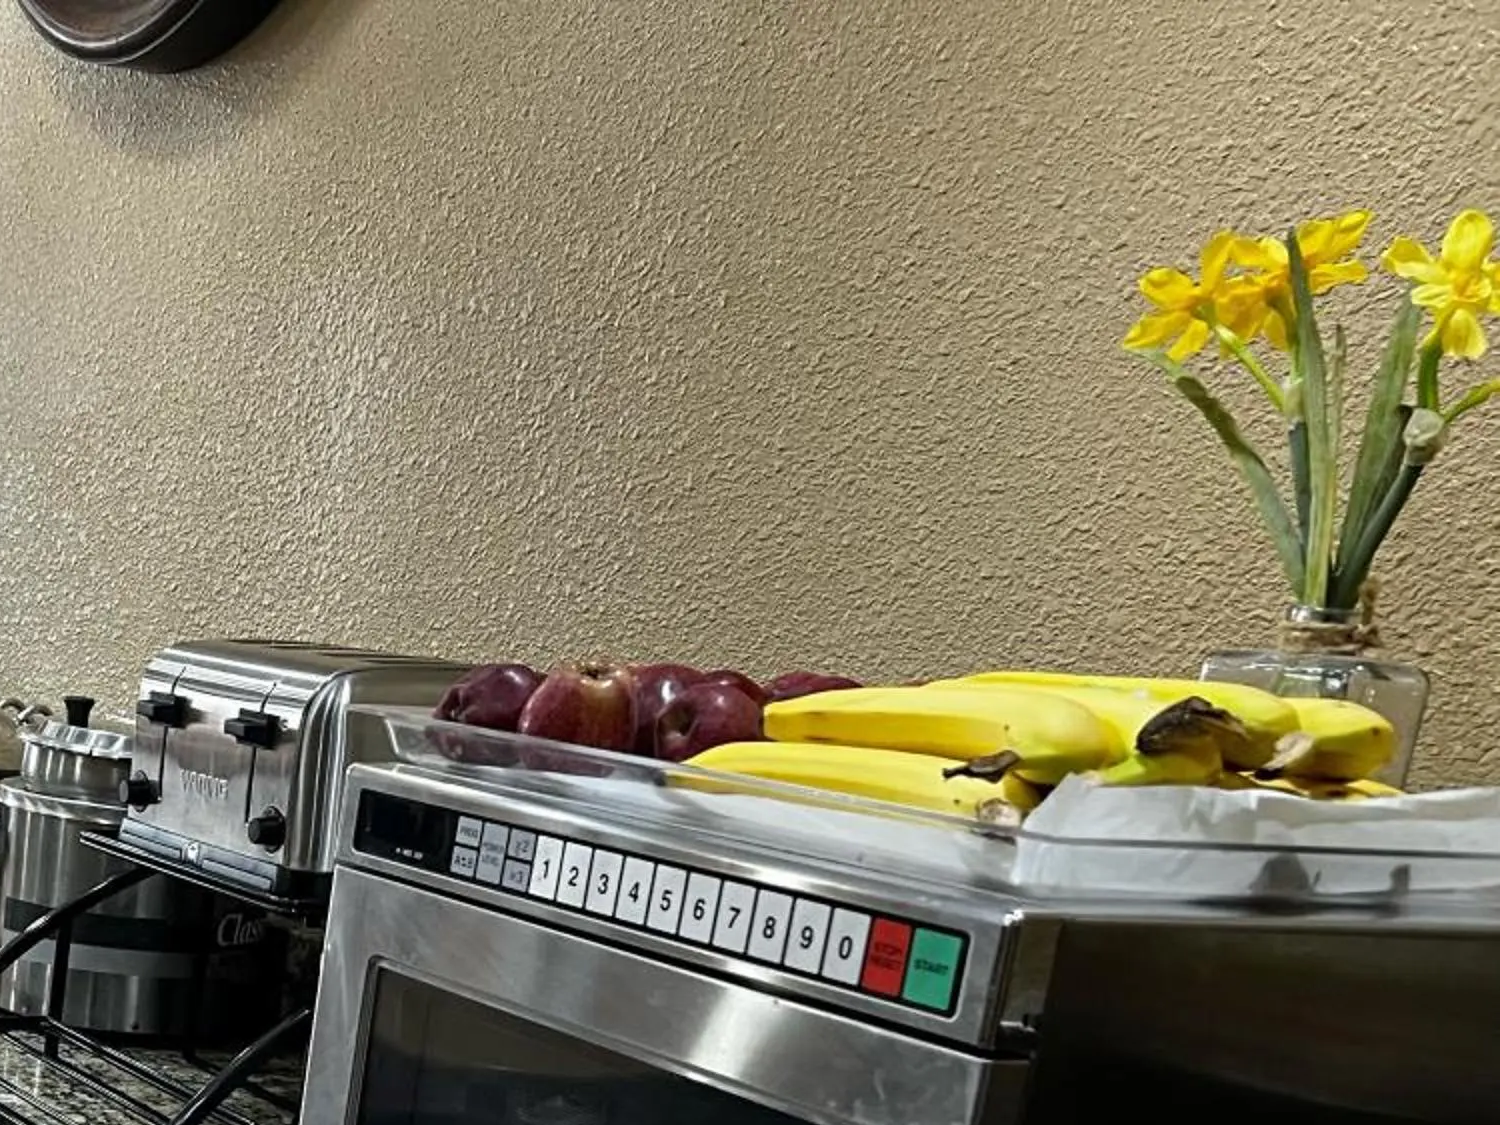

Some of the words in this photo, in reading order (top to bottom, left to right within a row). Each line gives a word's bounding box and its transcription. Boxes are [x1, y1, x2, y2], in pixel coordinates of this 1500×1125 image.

[543, 860, 550, 879] 1
[568, 866, 580, 887] 2
[598, 873, 610, 895] 3
[628, 881, 641, 903] 4
[660, 889, 673, 911] 5
[693, 898, 707, 921] 6
[727, 906, 741, 929] 7
[762, 915, 776, 939] 8
[799, 925, 814, 949] 9
[838, 935, 853, 960] 0
